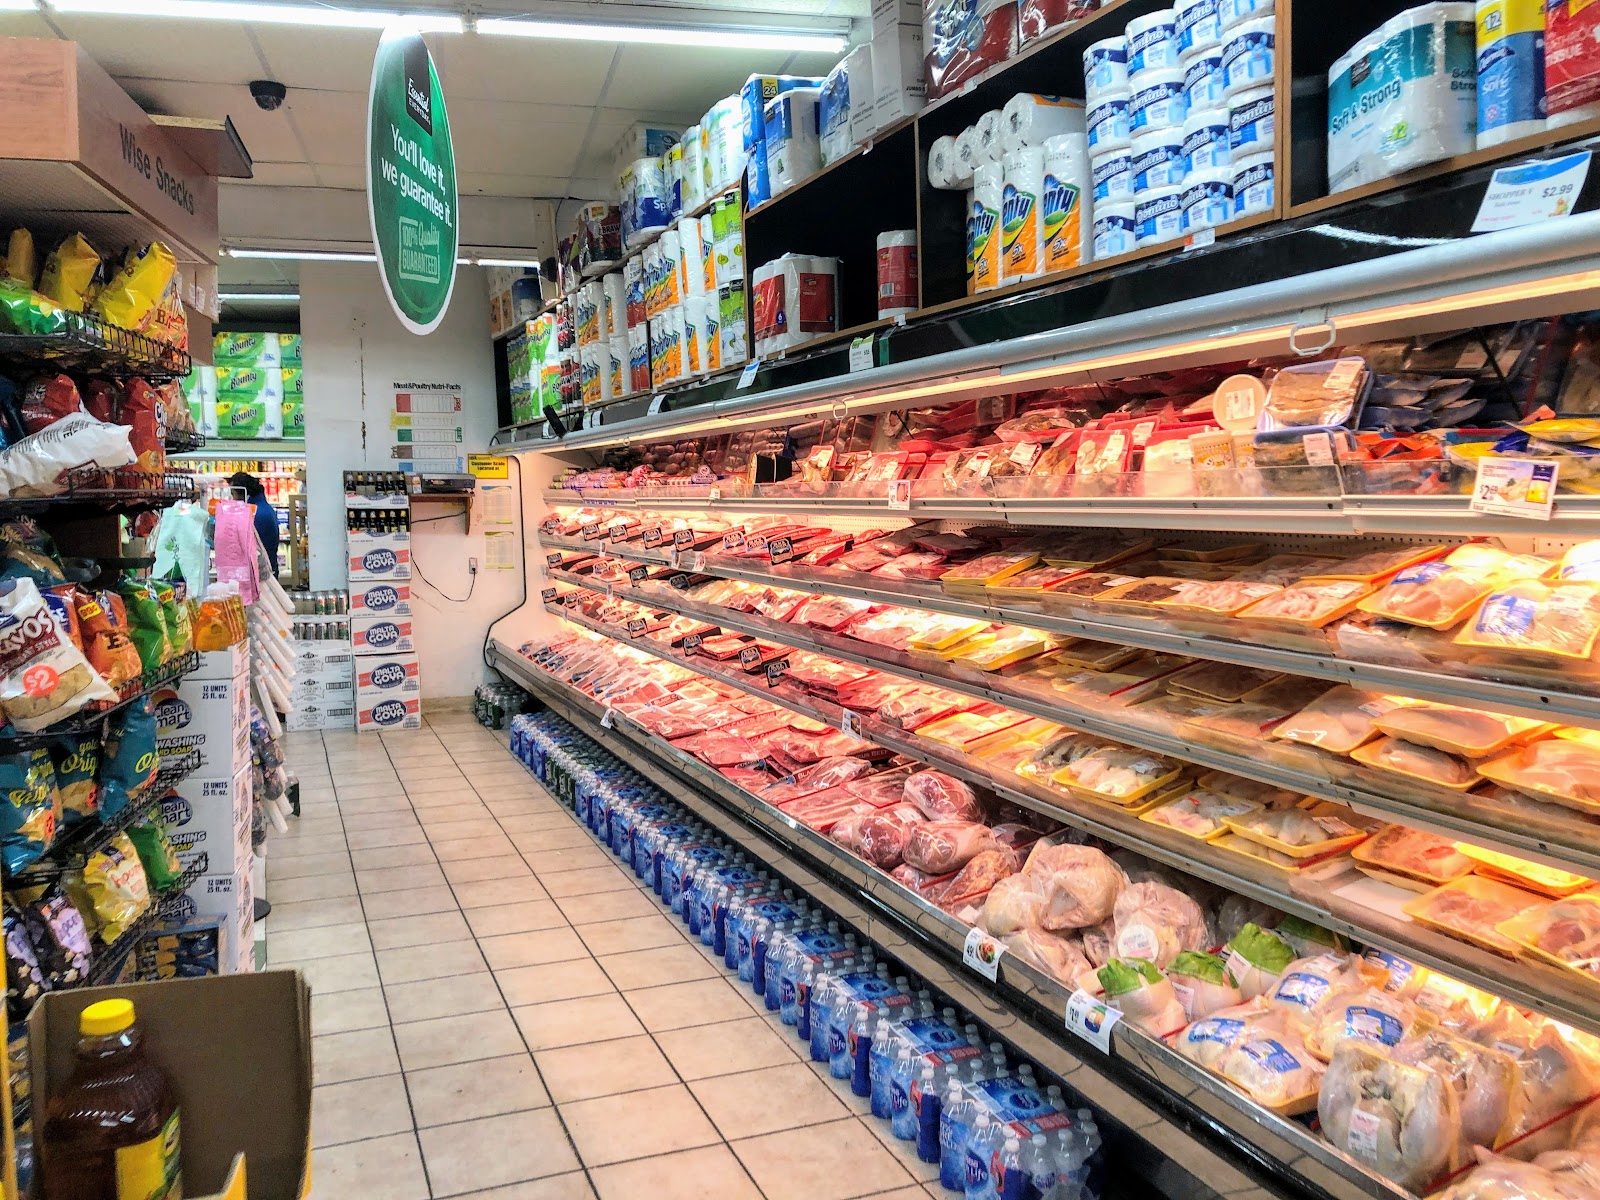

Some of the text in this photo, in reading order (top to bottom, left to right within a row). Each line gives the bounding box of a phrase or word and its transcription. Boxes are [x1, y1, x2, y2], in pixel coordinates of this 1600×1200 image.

[1486, 10, 1502, 30] 12
[763, 85, 777, 96] 24
[1450, 80, 1477, 91] Stro
[408, 77, 430, 113] Essential
[1332, 79, 1401, 135] Soft & Strong
[1232, 100, 1275, 132] Domin
[391, 123, 418, 168] You'll
[419, 147, 437, 184] love
[119, 123, 195, 216] Wise Snacks
[381, 157, 453, 229] we guarantee it.
[1541, 183, 1574, 199] $2.99
[602, 224, 620, 235] BRAW
[402, 221, 440, 253] 100% Quality
[402, 248, 438, 276] GUARANTEED
[777, 313, 783, 321] 6
[229, 336, 257, 356] Bounty
[230, 371, 257, 391] Bounty
[231, 407, 257, 427] Bounty
[367, 551, 392, 561] MALTA
[365, 558, 396, 569] GOYA
[368, 588, 394, 598] MALTA
[367, 595, 397, 607] GOYA
[0, 609, 54, 655] AVOS
[369, 625, 395, 635] MALTA
[368, 631, 398, 643] GOYA
[375, 665, 400, 676] MALTA
[26, 669, 55, 691] $2
[374, 672, 404, 685] GOYA
[375, 702, 402, 713] MALTA
[374, 709, 405, 721] GOYA
[157, 734, 206, 749] WASHING
[798, 769, 812, 779] BLA
[210, 781, 228, 789] UNITS
[202, 789, 210, 797] 25
[161, 801, 186, 814] lean
[169, 831, 206, 846] SHING
[207, 878, 232, 887] 12 UNITS
[206, 886, 214, 894] 25
